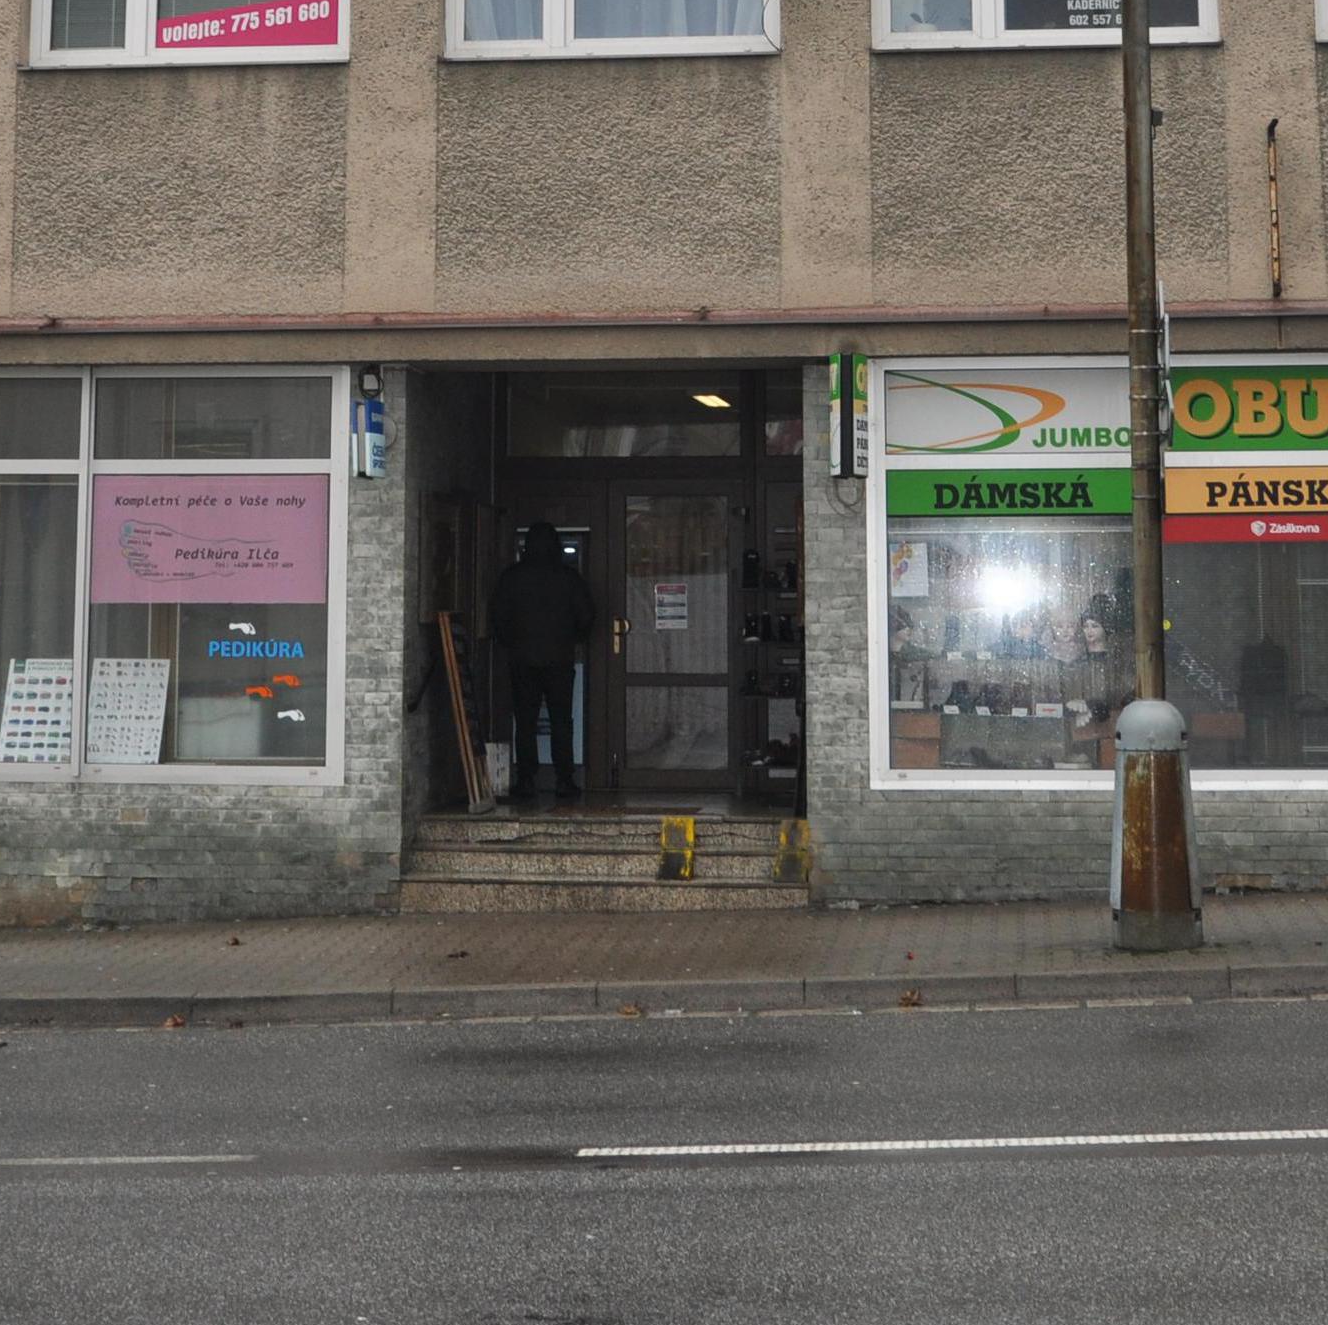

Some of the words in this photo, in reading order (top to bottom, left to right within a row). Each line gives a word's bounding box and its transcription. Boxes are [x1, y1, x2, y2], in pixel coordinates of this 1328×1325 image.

[231, 11, 260, 33] 775
[265, 5, 293, 27] 561
[298, 0, 330, 22] 680
[1032, 427, 1133, 448] JUMBO
[115, 495, 181, 508] Kompletní
[187, 495, 218, 508] péče
[224, 497, 233, 507] o
[240, 495, 269, 507] Vaše
[275, 495, 307, 509] nohy
[933, 475, 1093, 510] DÁMSKÁ
[174, 547, 239, 561] Pedikúra
[247, 547, 280, 561] Ilča
[208, 638, 305, 658] PEDIKÚRA
